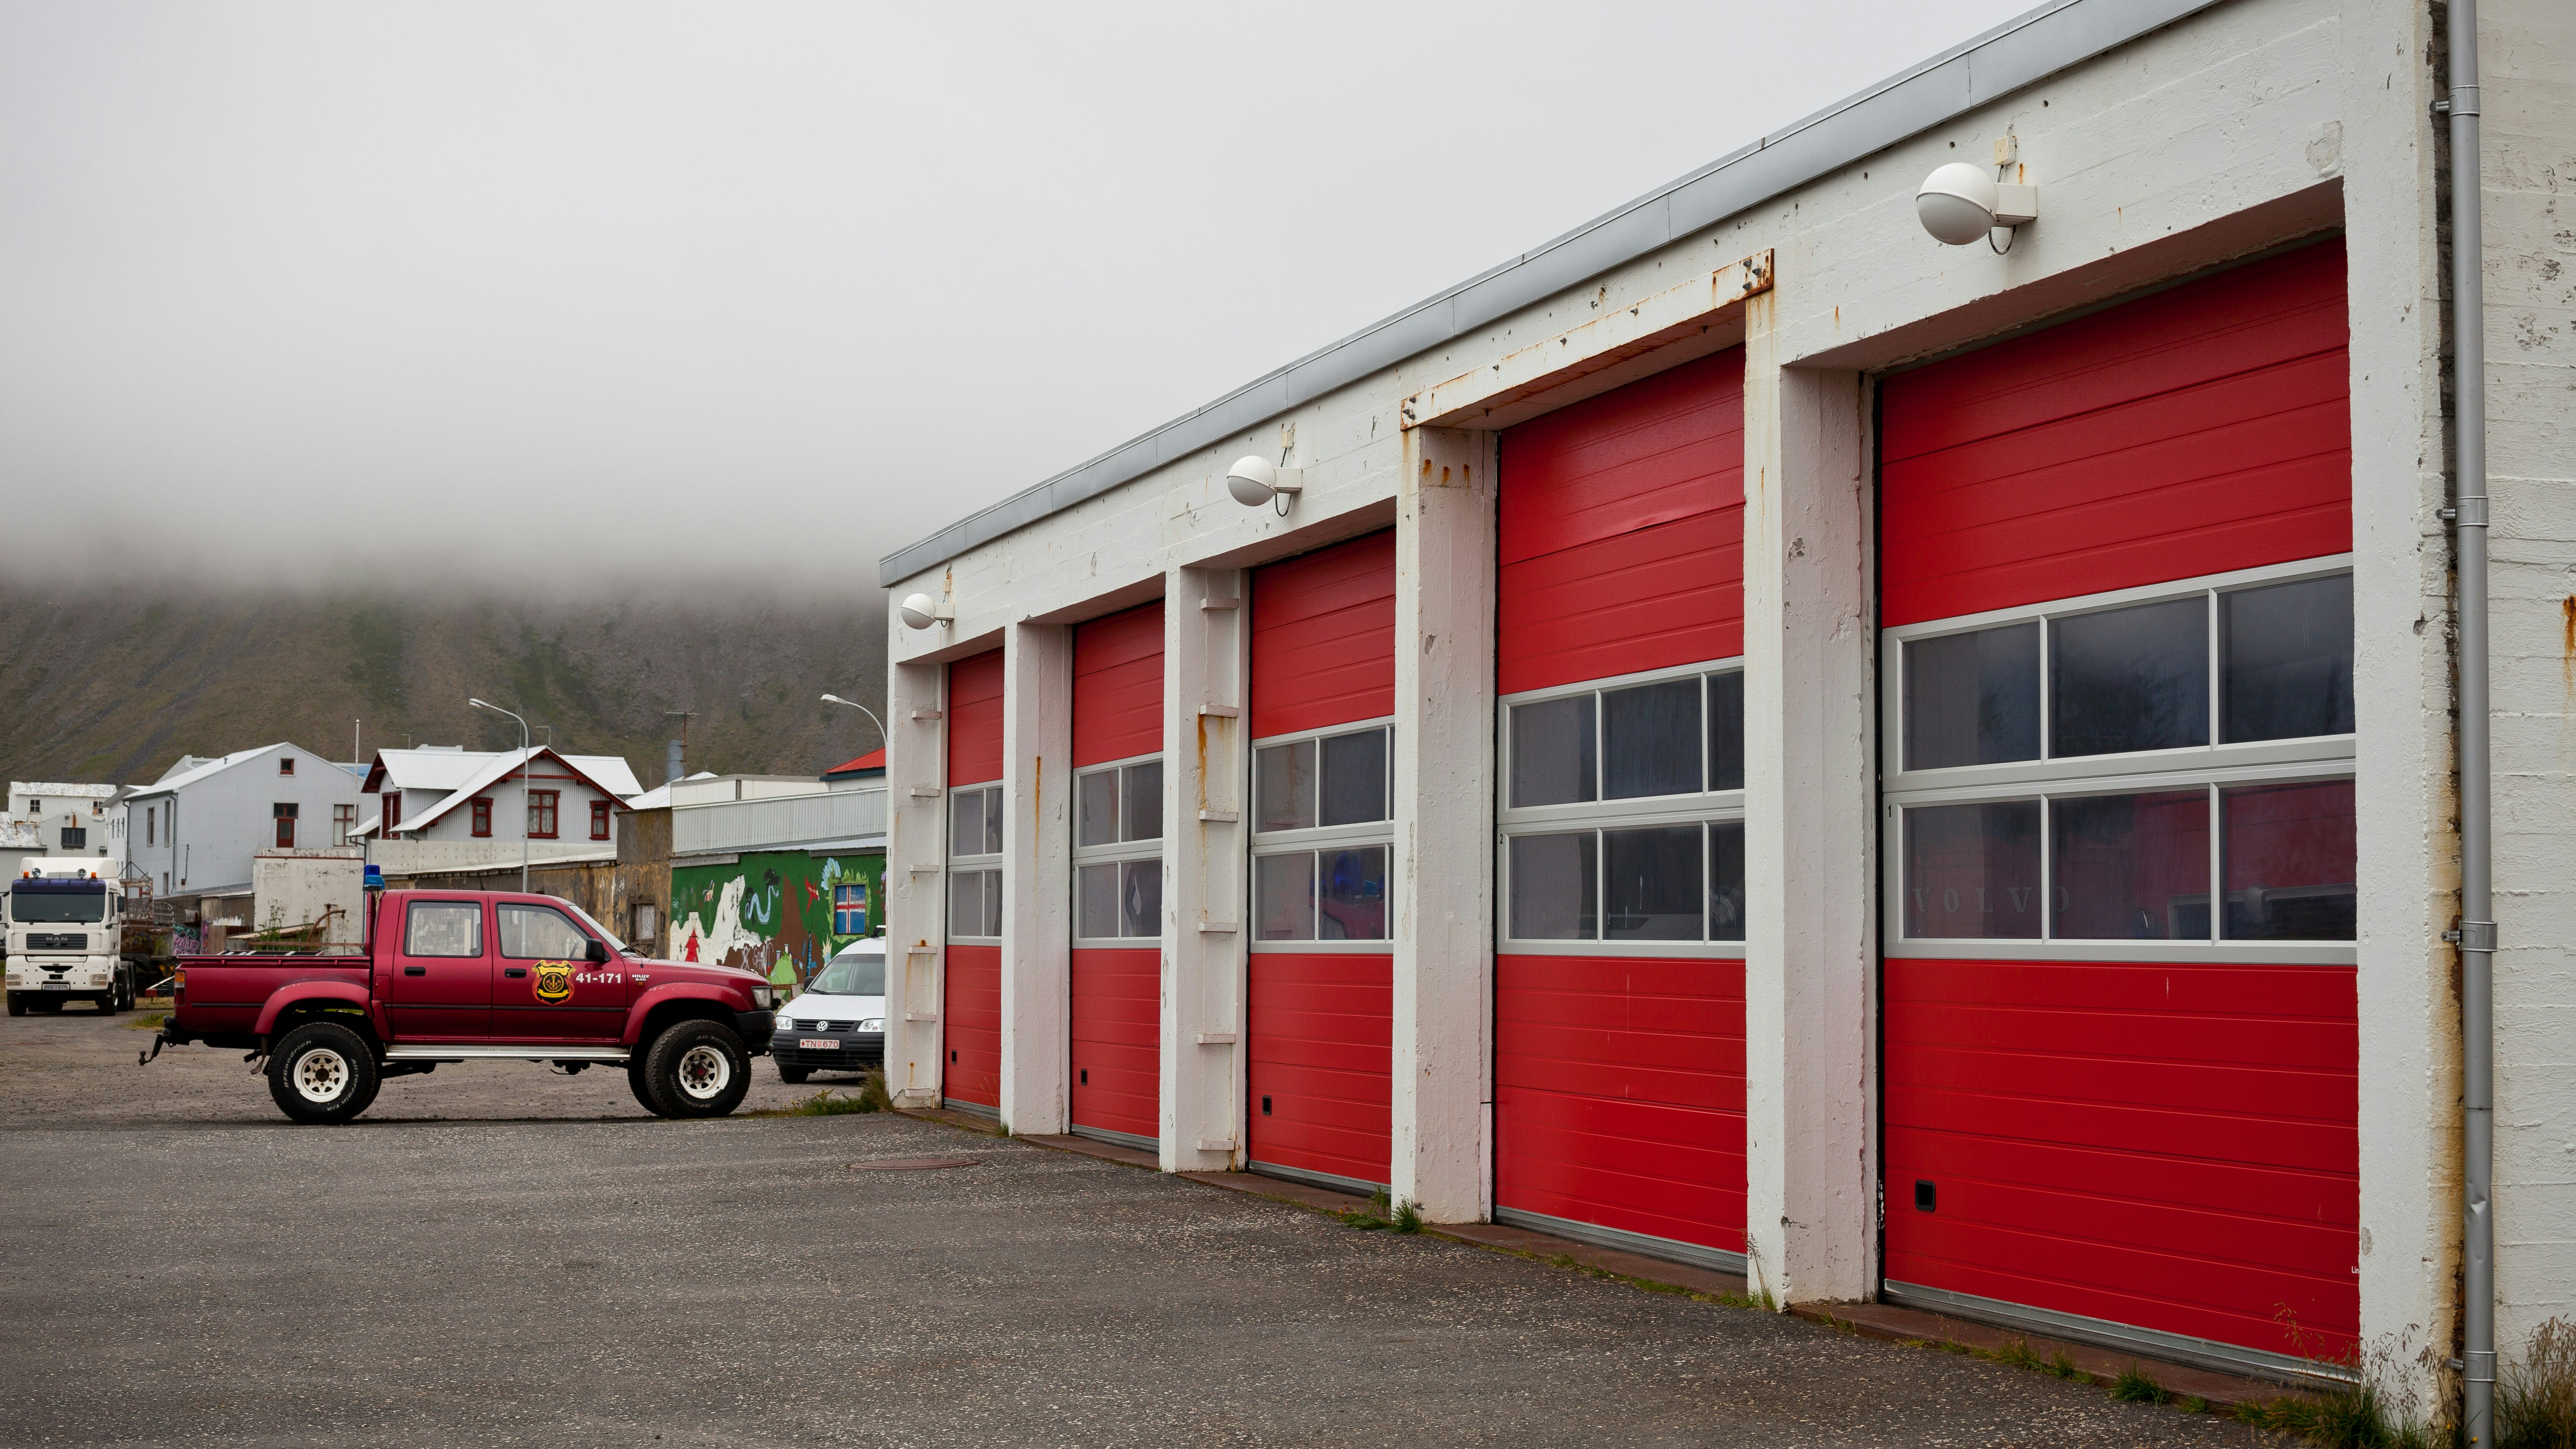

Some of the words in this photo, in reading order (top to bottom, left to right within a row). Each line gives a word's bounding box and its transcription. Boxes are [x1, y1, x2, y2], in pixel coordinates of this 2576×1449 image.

[1888, 804, 1892, 818] 1
[1499, 833, 1503, 844] 2
[1912, 885, 2071, 913] VOLVO
[576, 972, 621, 983] 41-171
[283, 1040, 311, 1088] BFGoodrich
[341, 1058, 359, 1104] All-Terrain
[2351, 1266, 2359, 1274] Lin
